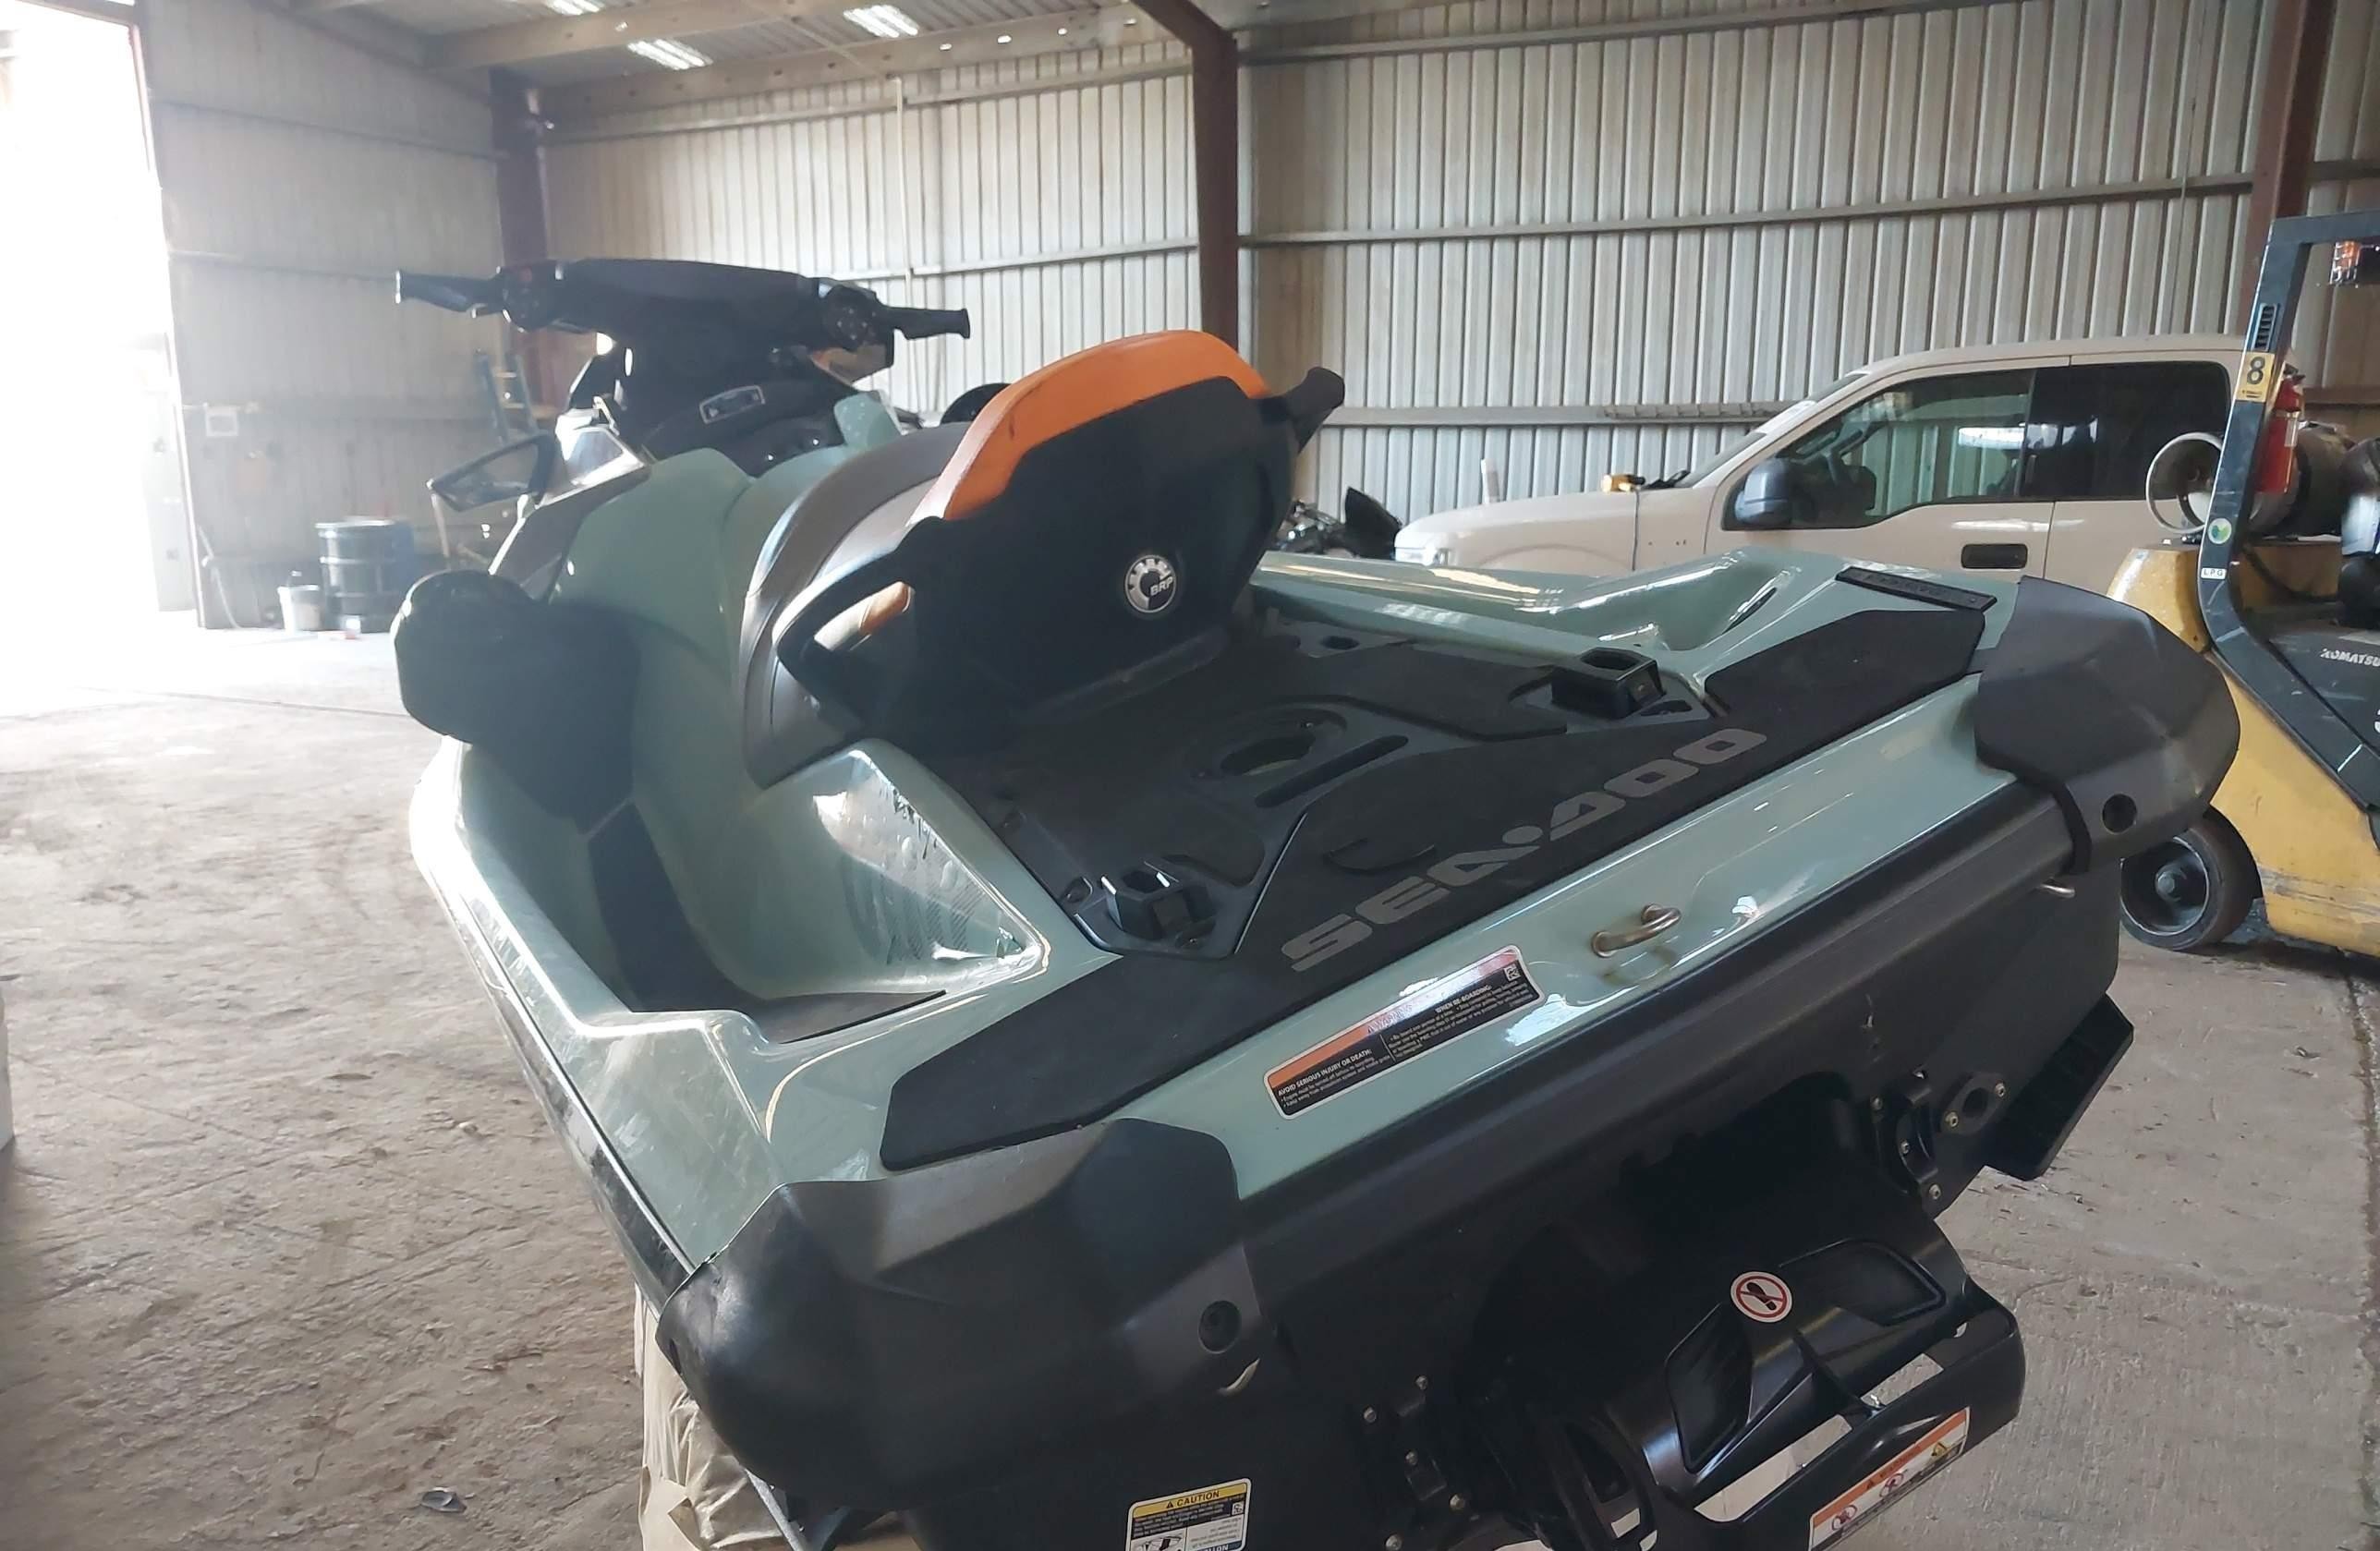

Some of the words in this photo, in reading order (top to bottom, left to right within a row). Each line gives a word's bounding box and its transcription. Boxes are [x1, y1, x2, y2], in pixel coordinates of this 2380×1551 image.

[2247, 357, 2265, 385] 8
[1150, 576, 1173, 596] BRP
[2319, 648, 2380, 667] KOMATSU
[1278, 1084, 1296, 1097] AVOID
[1296, 1072, 1321, 1087] SERIOUS
[1321, 1061, 1341, 1076] INJURY
[1342, 1058, 1352, 1066] OR
[1177, 1490, 1220, 1507] CAUTION
